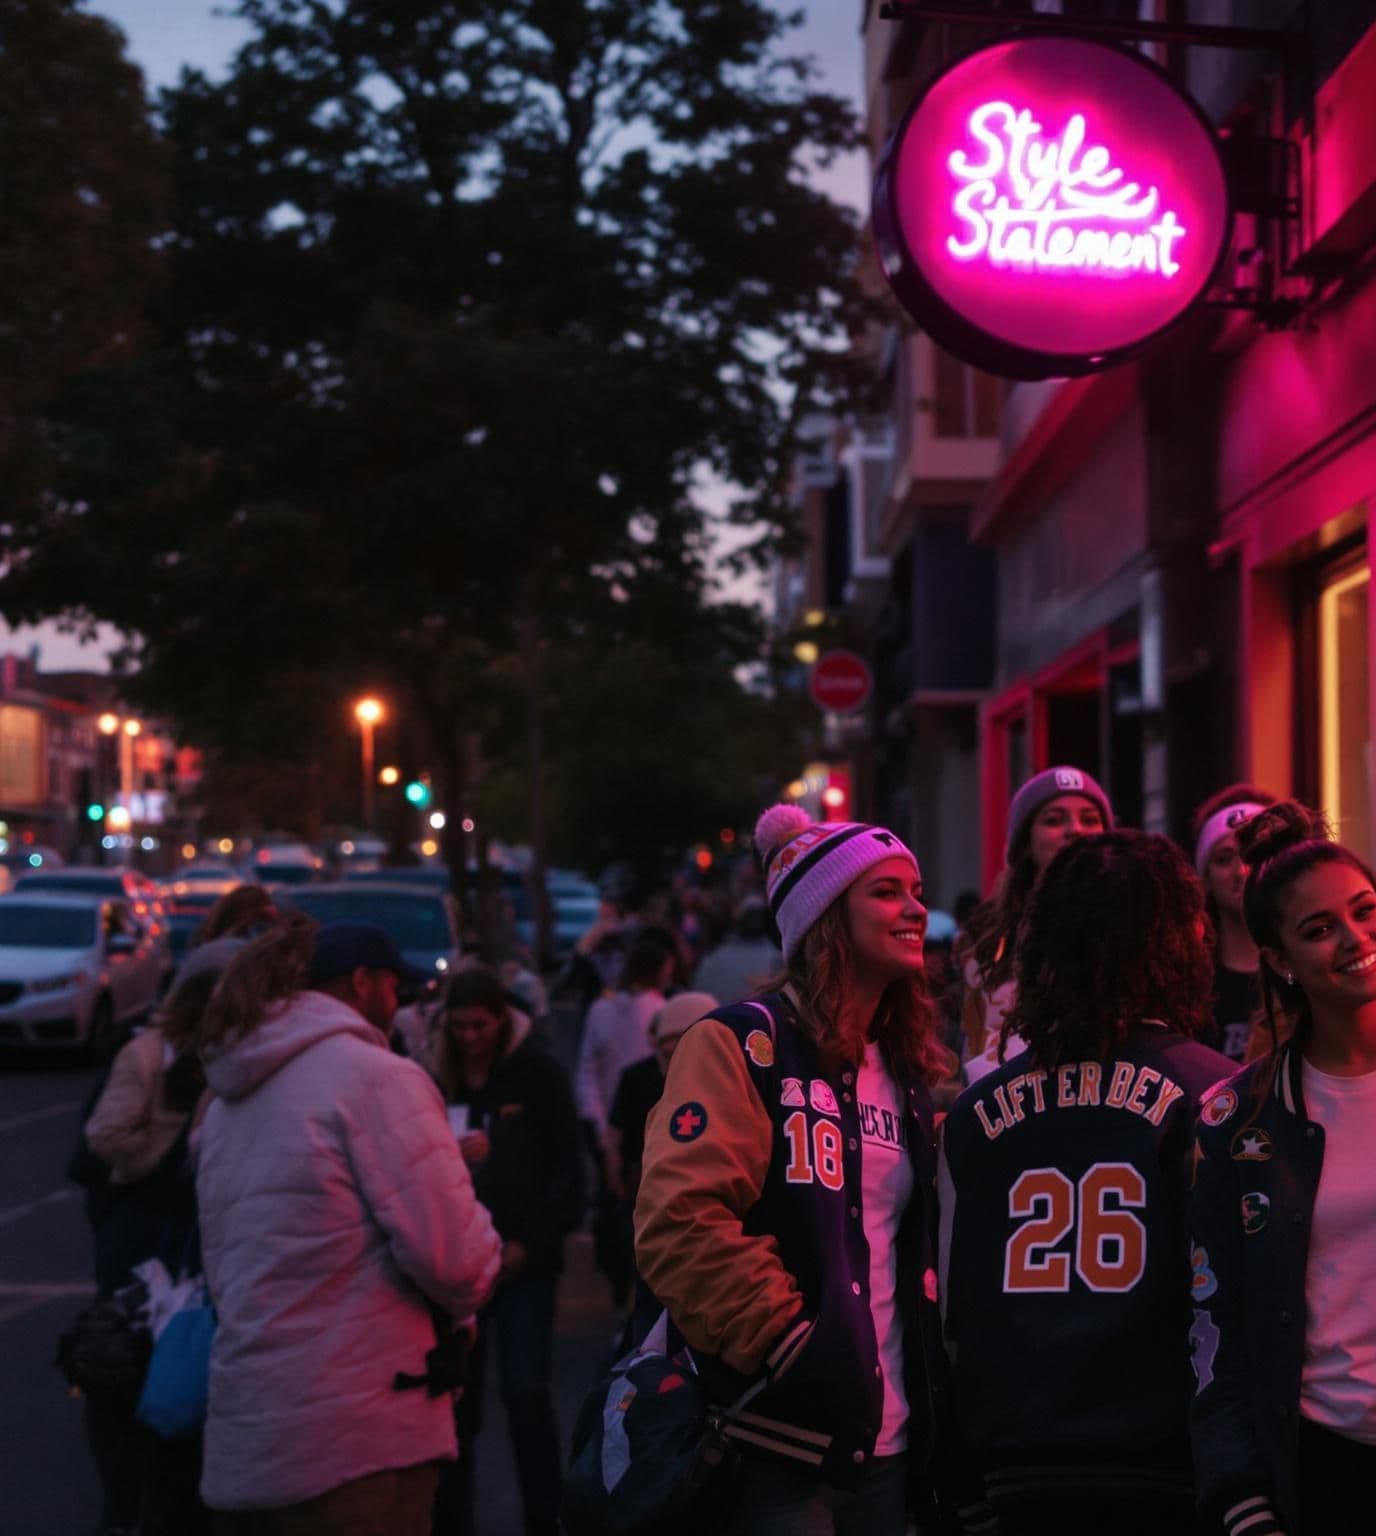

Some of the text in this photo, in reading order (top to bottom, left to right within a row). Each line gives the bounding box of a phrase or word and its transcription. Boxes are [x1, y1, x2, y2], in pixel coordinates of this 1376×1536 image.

[948, 101, 1123, 210] Style
[947, 179, 1185, 277] Statement
[784, 1112, 844, 1191] 18
[1003, 1162, 1146, 1293] 26
